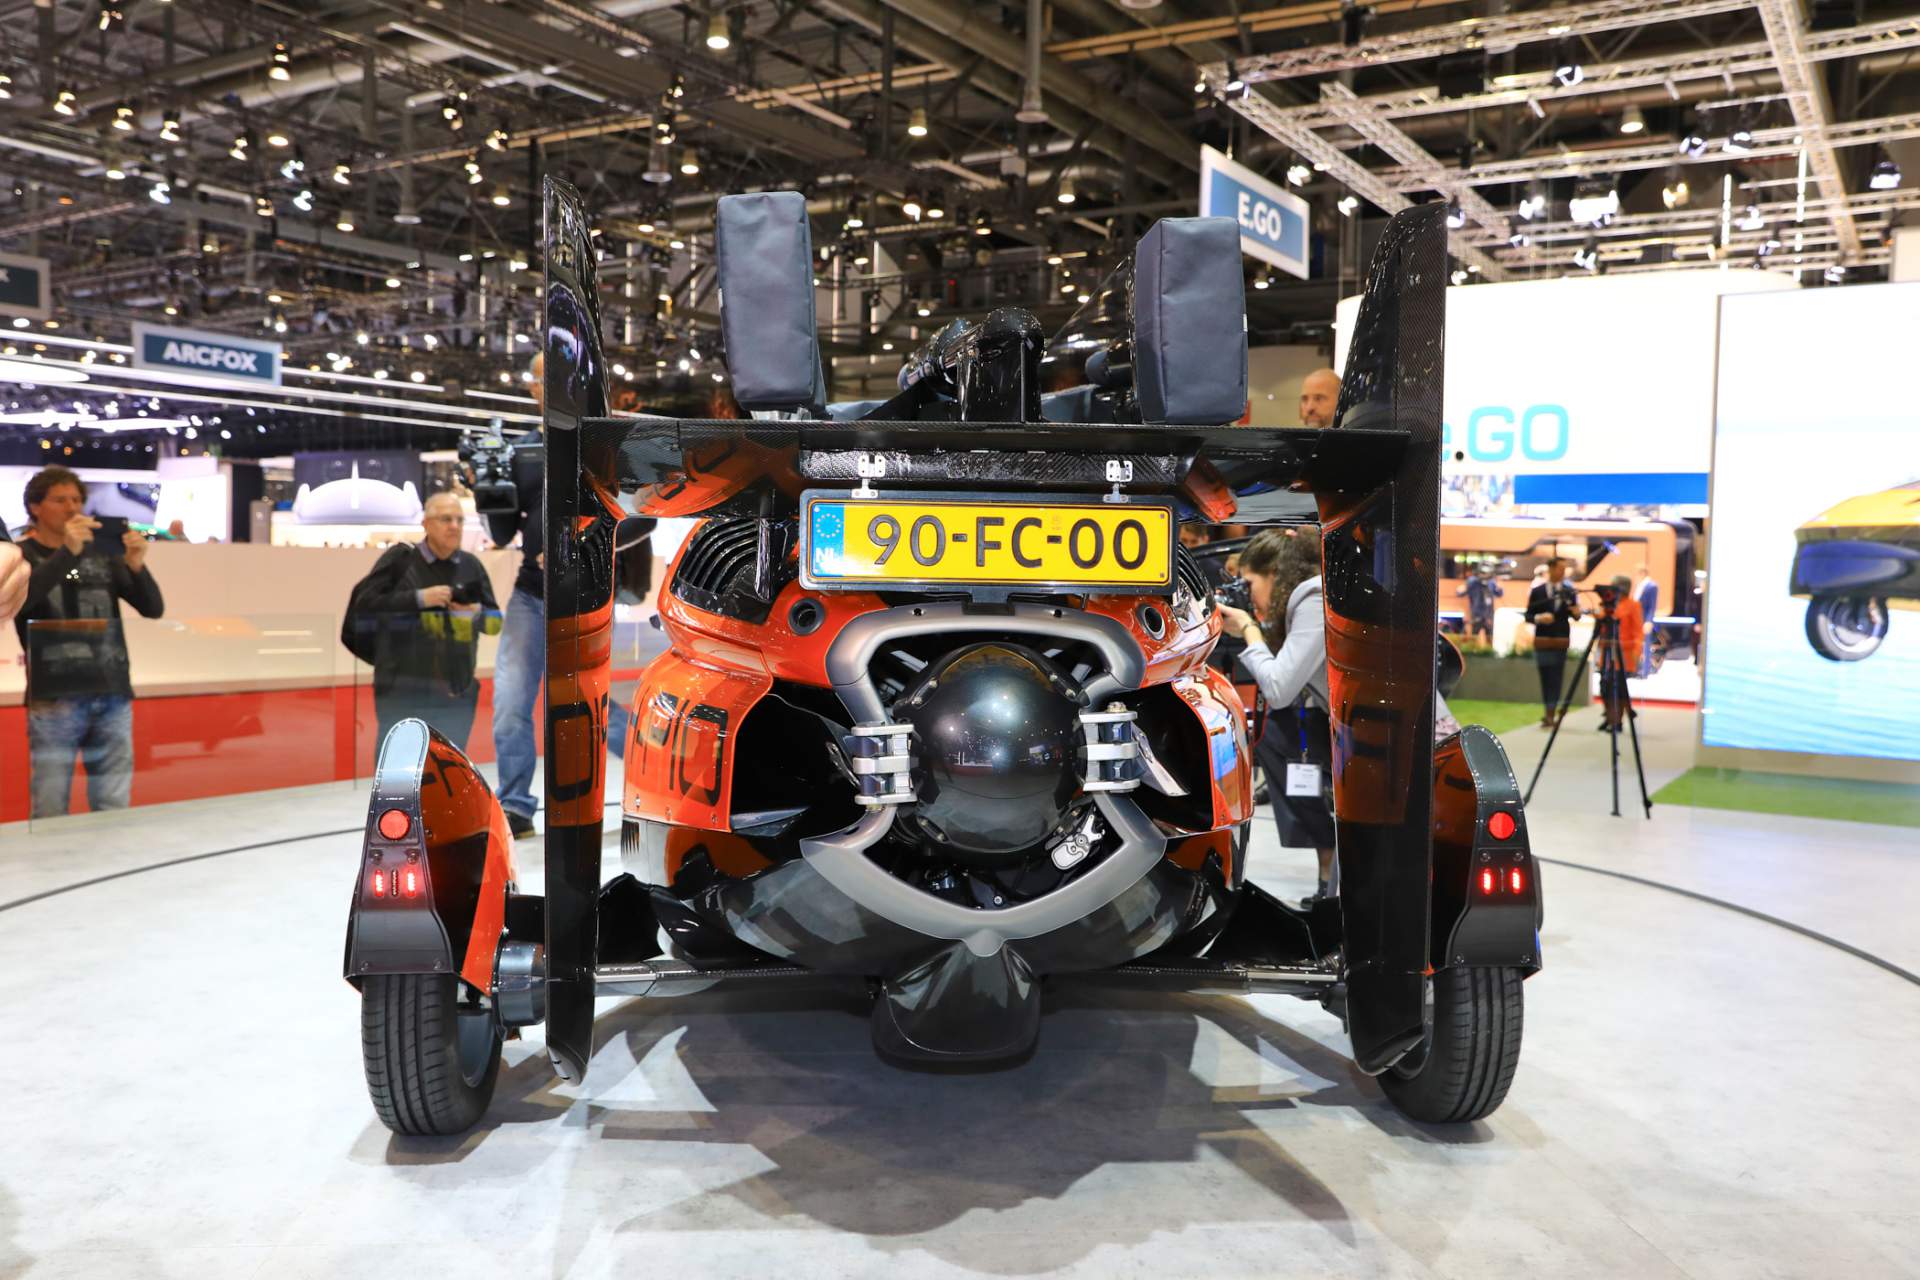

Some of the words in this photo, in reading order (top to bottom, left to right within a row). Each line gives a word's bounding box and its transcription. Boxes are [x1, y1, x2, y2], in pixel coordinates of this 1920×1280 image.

[1238, 191, 1282, 241] E.GO
[162, 341, 258, 373] ARCFOX
[815, 546, 838, 563] NL
[867, 514, 1148, 570] 90-FC-00
